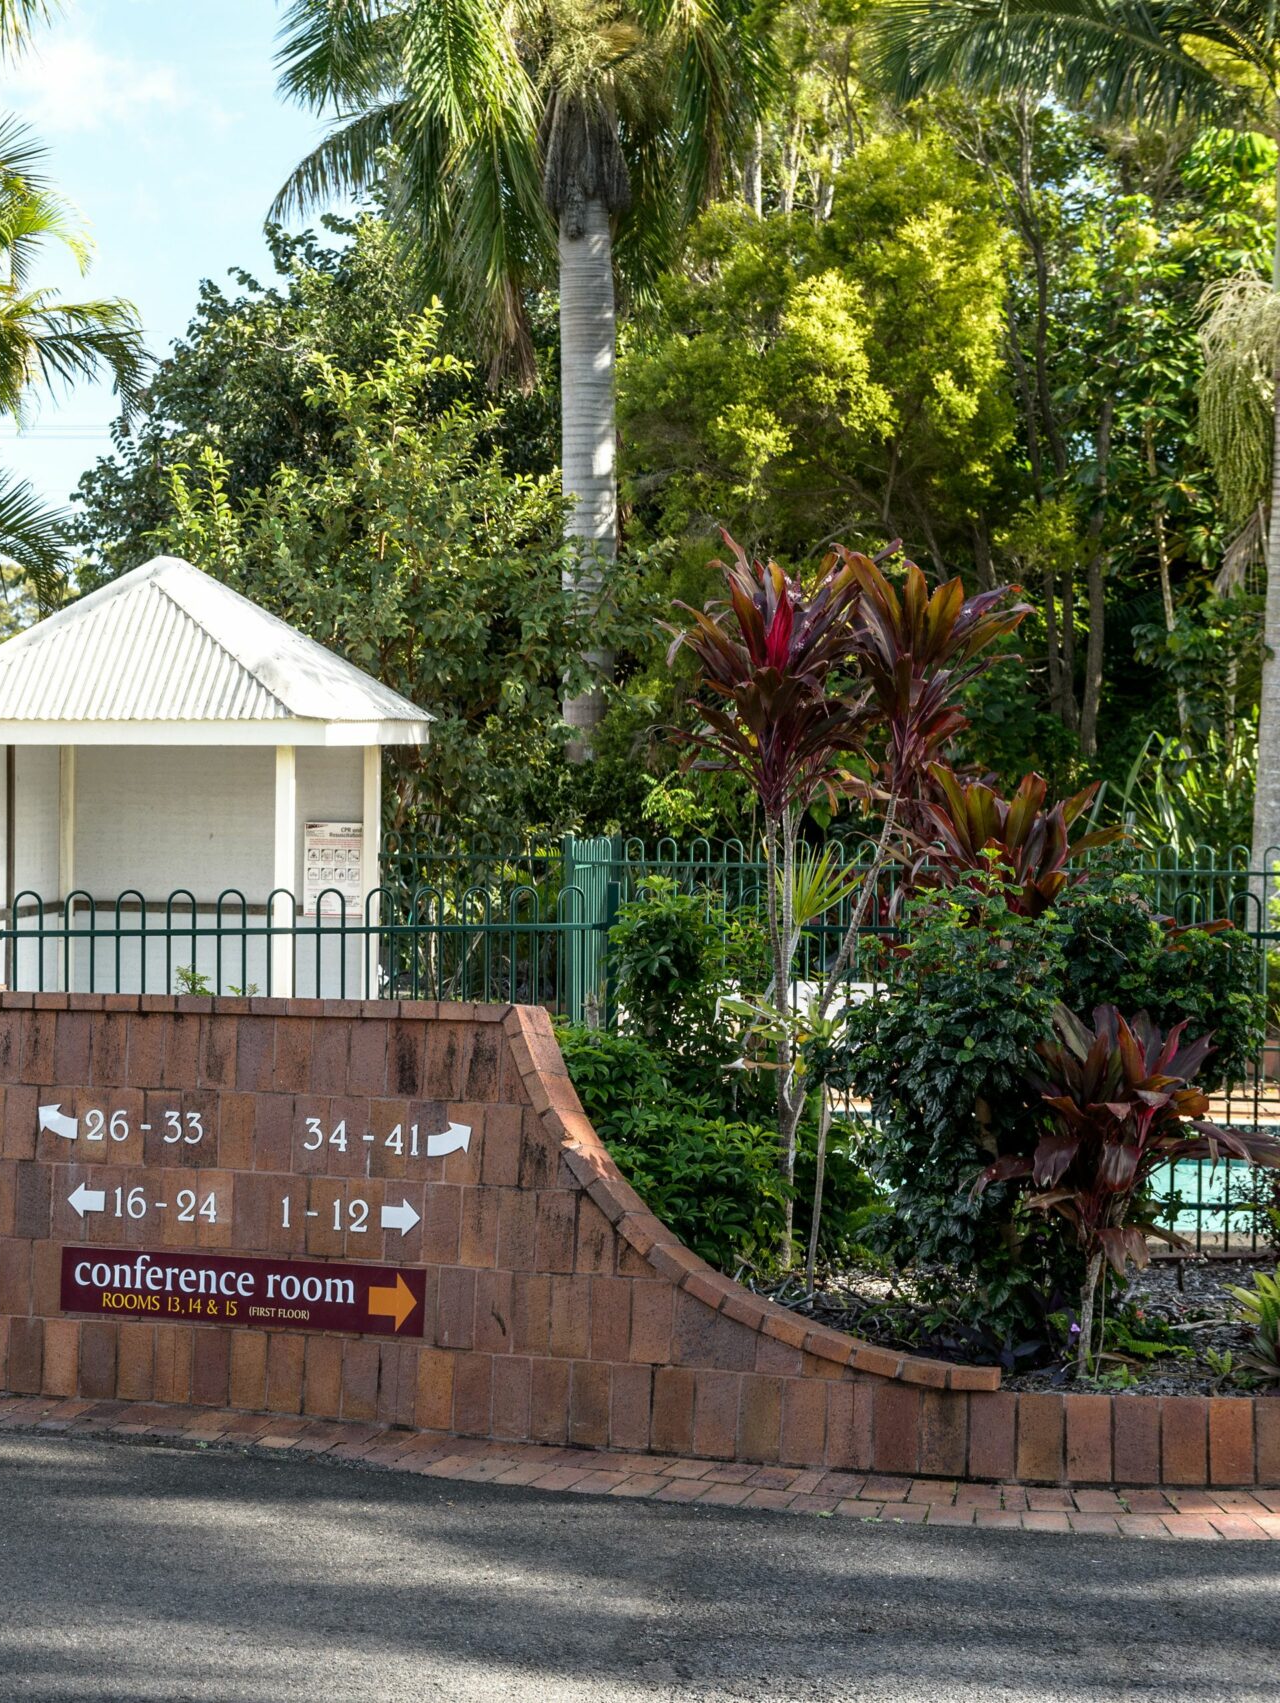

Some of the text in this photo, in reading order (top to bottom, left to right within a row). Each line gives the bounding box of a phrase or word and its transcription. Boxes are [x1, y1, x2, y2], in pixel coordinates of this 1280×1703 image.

[85, 1110, 129, 1141] 26
[163, 1110, 203, 1145] 33
[303, 1118, 347, 1152] 34
[385, 1123, 420, 1156] 41
[114, 1187, 147, 1219] 16
[177, 1190, 217, 1223] 24
[281, 1196, 290, 1228] 1
[333, 1199, 369, 1232] 12
[74, 1255, 355, 1304] conference room
[102, 1292, 160, 1311] ROOMS
[207, 1300, 218, 1315] &
[226, 1300, 237, 1316] 15
[249, 1306, 276, 1319] (FIRST
[278, 1307, 310, 1320] FLOOR)
